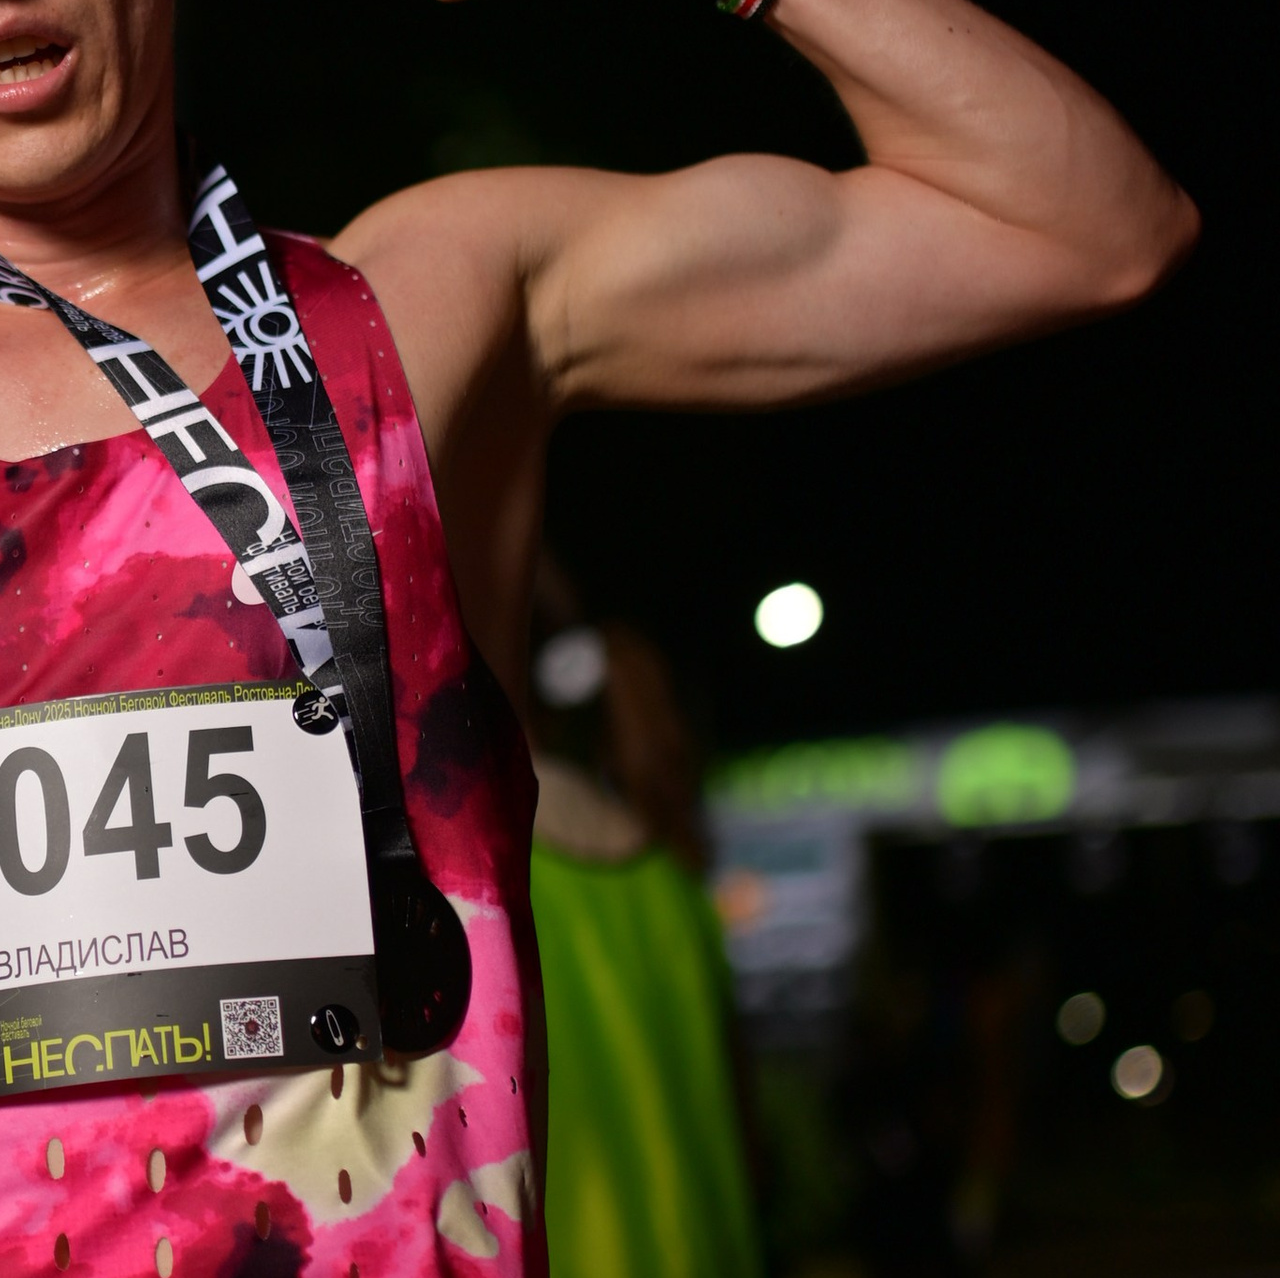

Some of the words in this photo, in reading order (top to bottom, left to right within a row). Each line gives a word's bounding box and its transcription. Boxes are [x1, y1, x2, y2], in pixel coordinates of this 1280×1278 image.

[44, 703, 72, 722] 2025
[74, 697, 117, 718] Ночной
[120, 691, 166, 713] Беговой
[169, 689, 232, 708] Фестиваль
[234, 681, 317, 703] Ростов-на-Д
